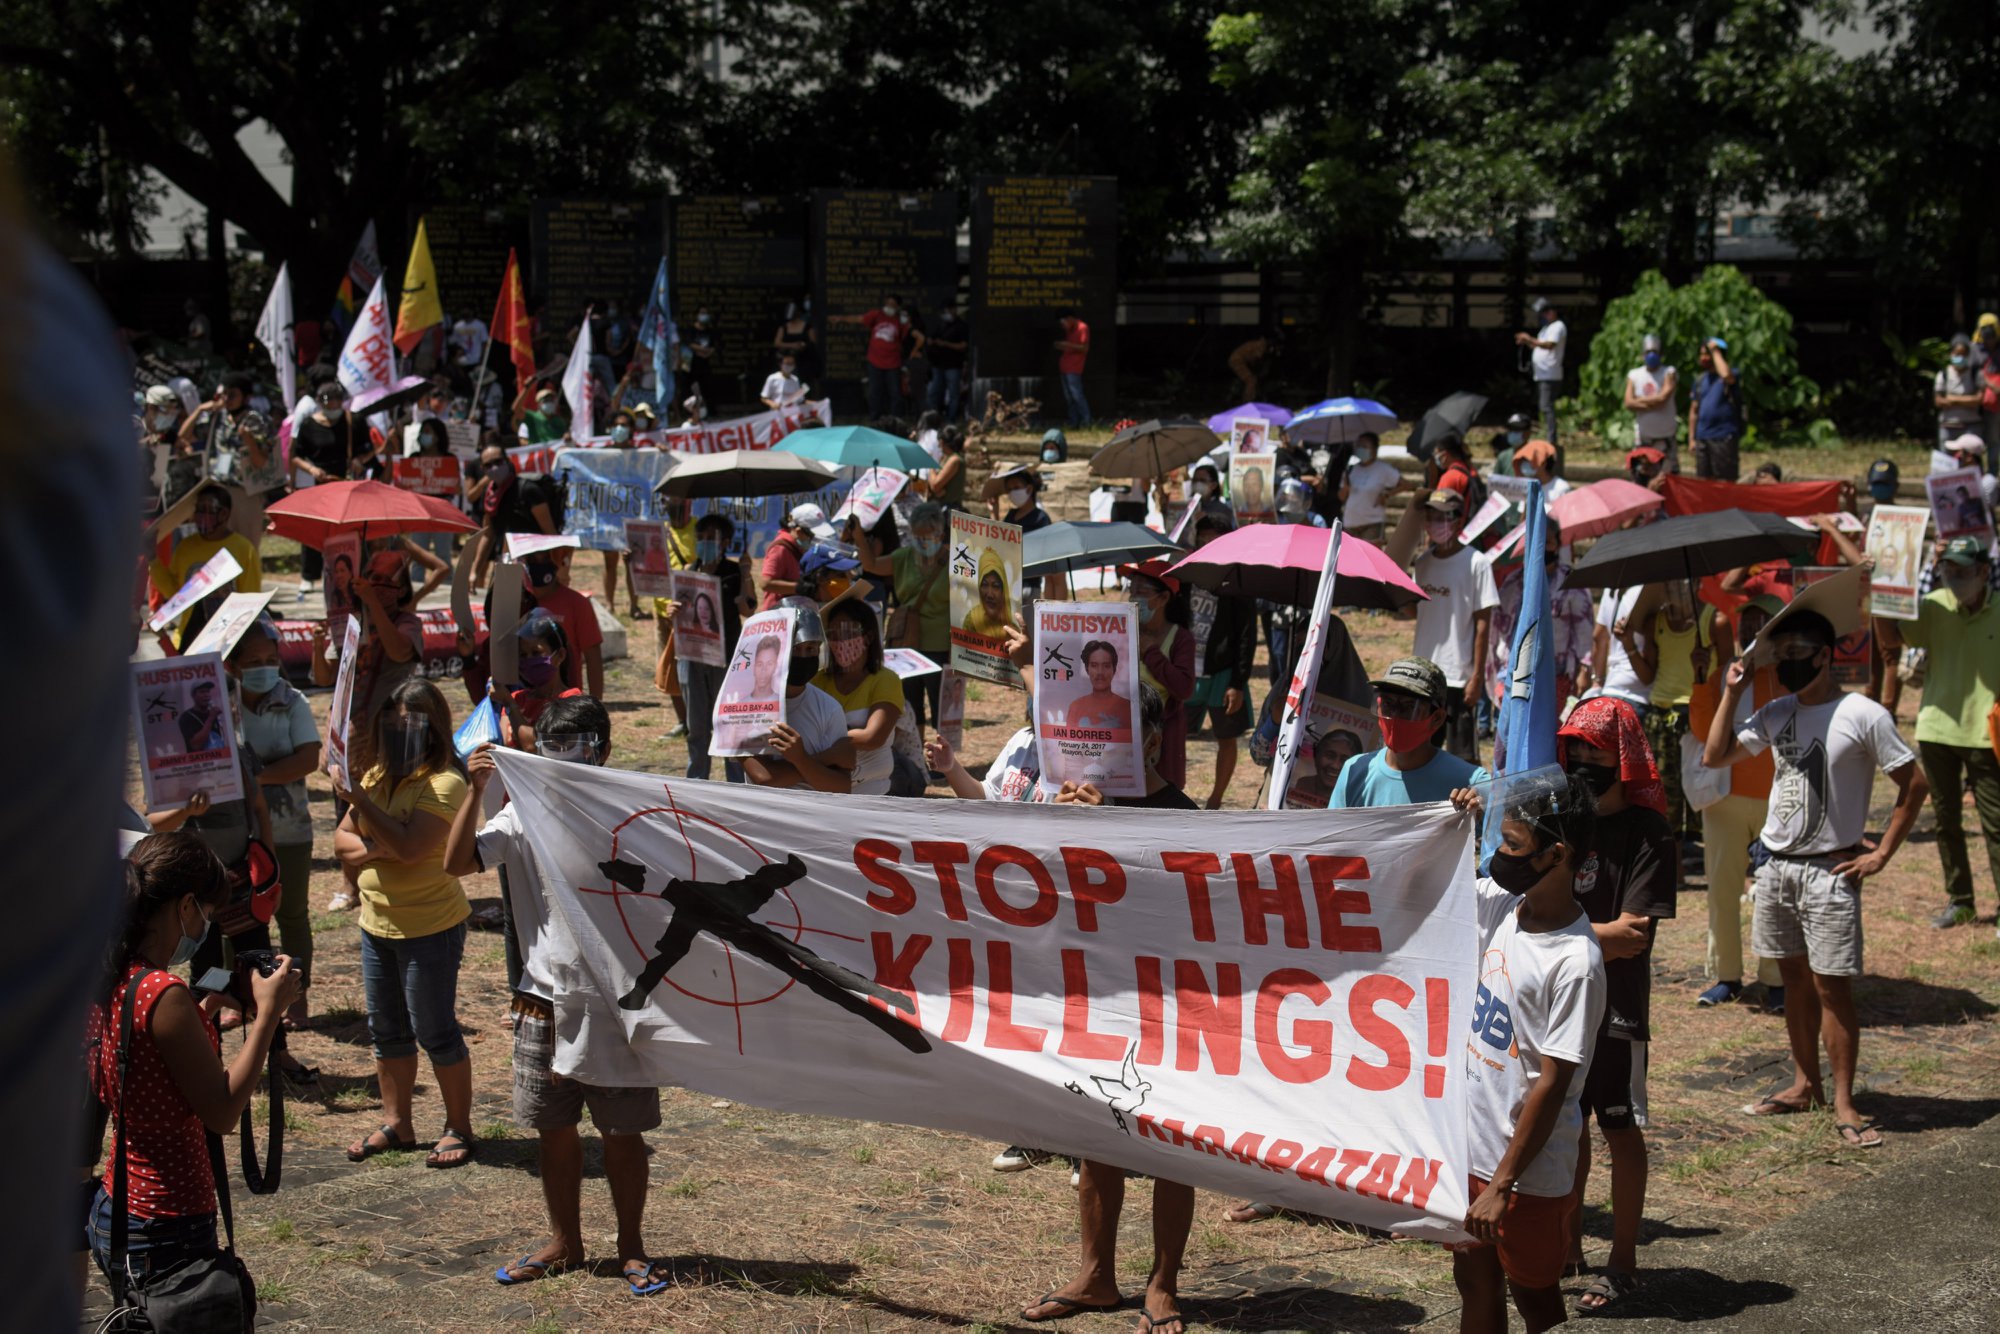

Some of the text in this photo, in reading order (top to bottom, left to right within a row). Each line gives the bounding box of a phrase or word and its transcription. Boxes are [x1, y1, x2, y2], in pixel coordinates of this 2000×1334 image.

[564, 481, 644, 516] CIENTISTS
[952, 515, 1022, 545] HUSTISYA!
[953, 564, 977, 578] STOP
[1041, 613, 1127, 634] HUSTISYA!
[953, 631, 984, 647] MARIAM
[985, 640, 997, 651] UY
[136, 662, 217, 686] HUSTISYA!
[731, 661, 751, 673] STOP
[1044, 667, 1074, 681] STOP
[723, 703, 774, 713] OBELLO BAY-AO
[1308, 702, 1375, 732] USTISYA!
[148, 711, 178, 724] STOP
[1053, 728, 1112, 740] IAN BORRES
[1058, 741, 1082, 749] February
[1082, 742, 1090, 750] 24,
[1061, 748, 1083, 757] Maayon,
[159, 750, 223, 767] JIMMY SAYPAN
[854, 838, 1383, 953] STOP THE
[867, 931, 1450, 1098] KILLINGS!
[1136, 1113, 1444, 1210] KARAPATAN
